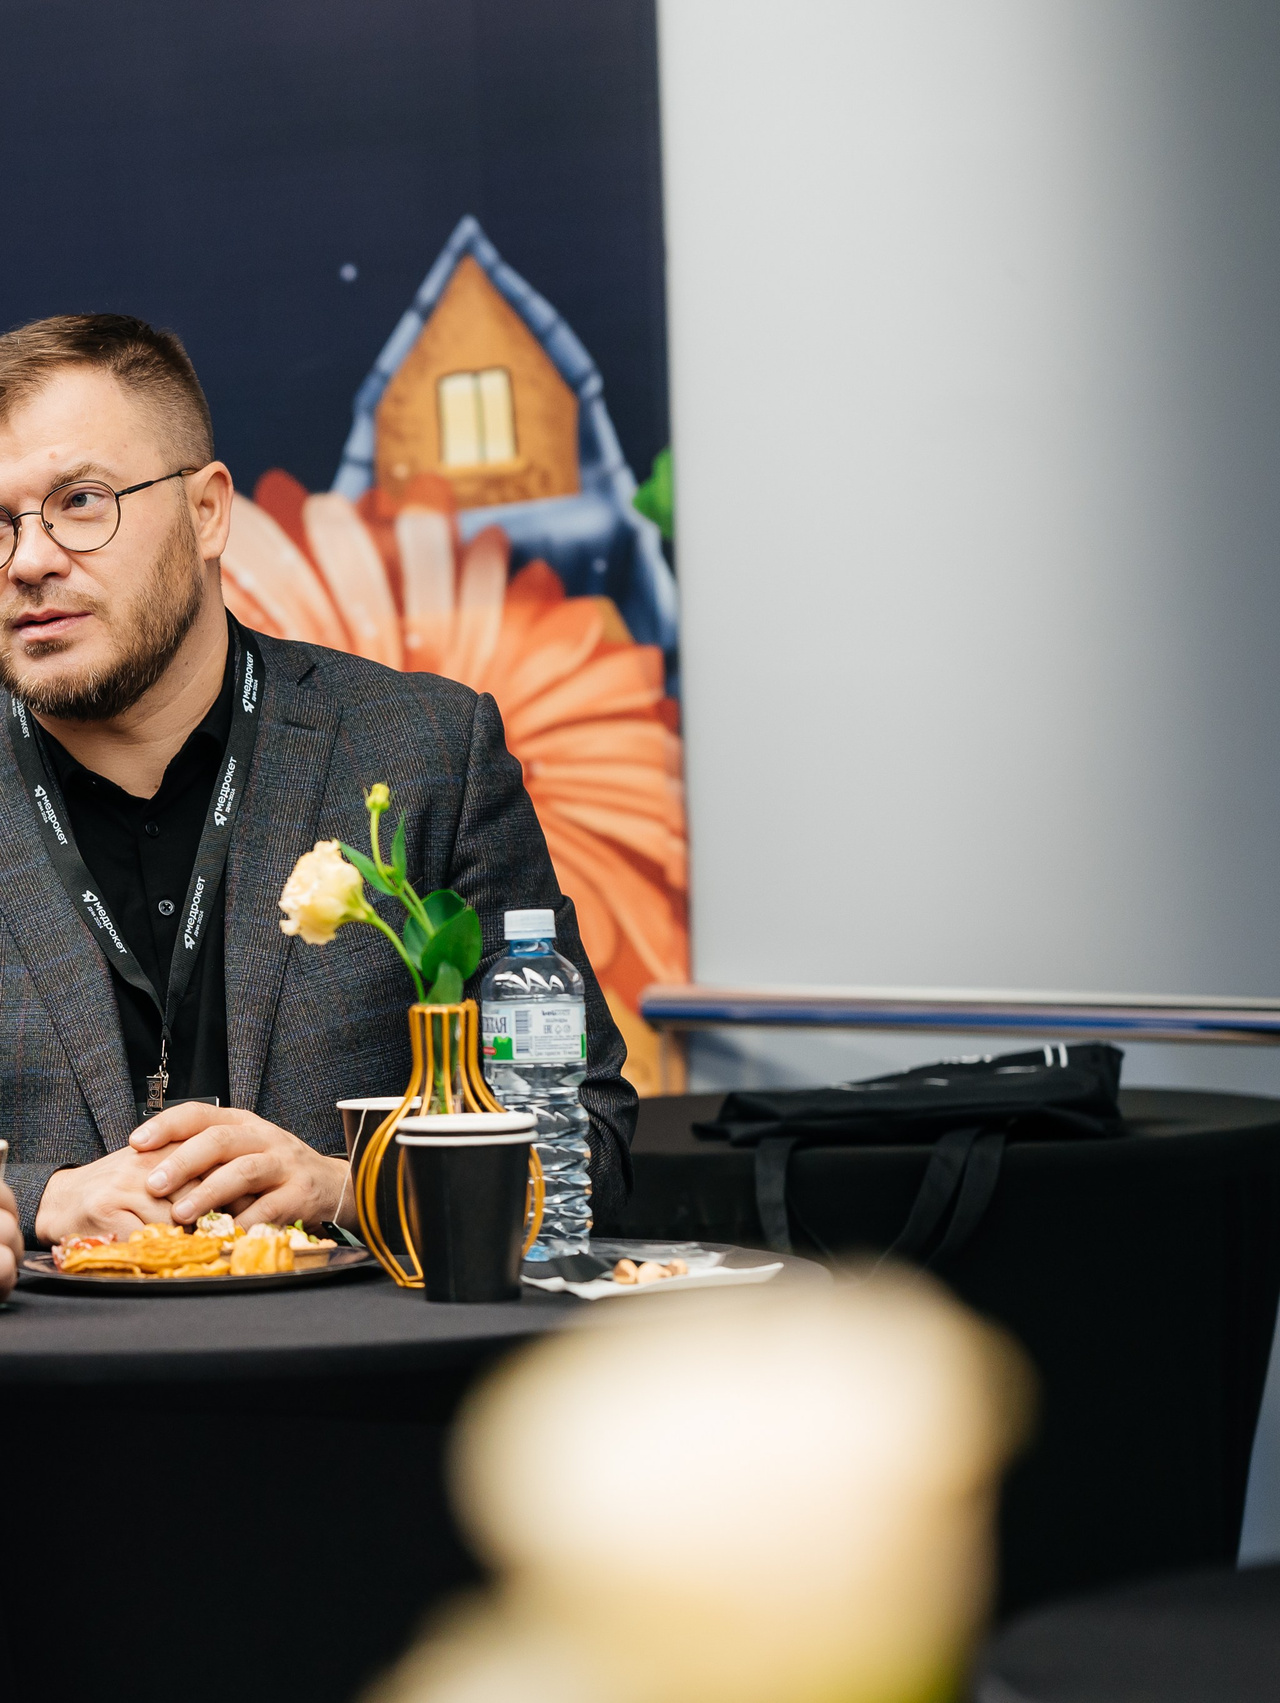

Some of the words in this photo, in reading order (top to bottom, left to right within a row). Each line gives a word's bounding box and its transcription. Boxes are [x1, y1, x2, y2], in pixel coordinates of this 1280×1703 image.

[215, 756, 237, 812] медрокет
[41, 794, 68, 846] медрокет
[93, 901, 128, 954] медрокет
[185, 875, 206, 934] медрокет
